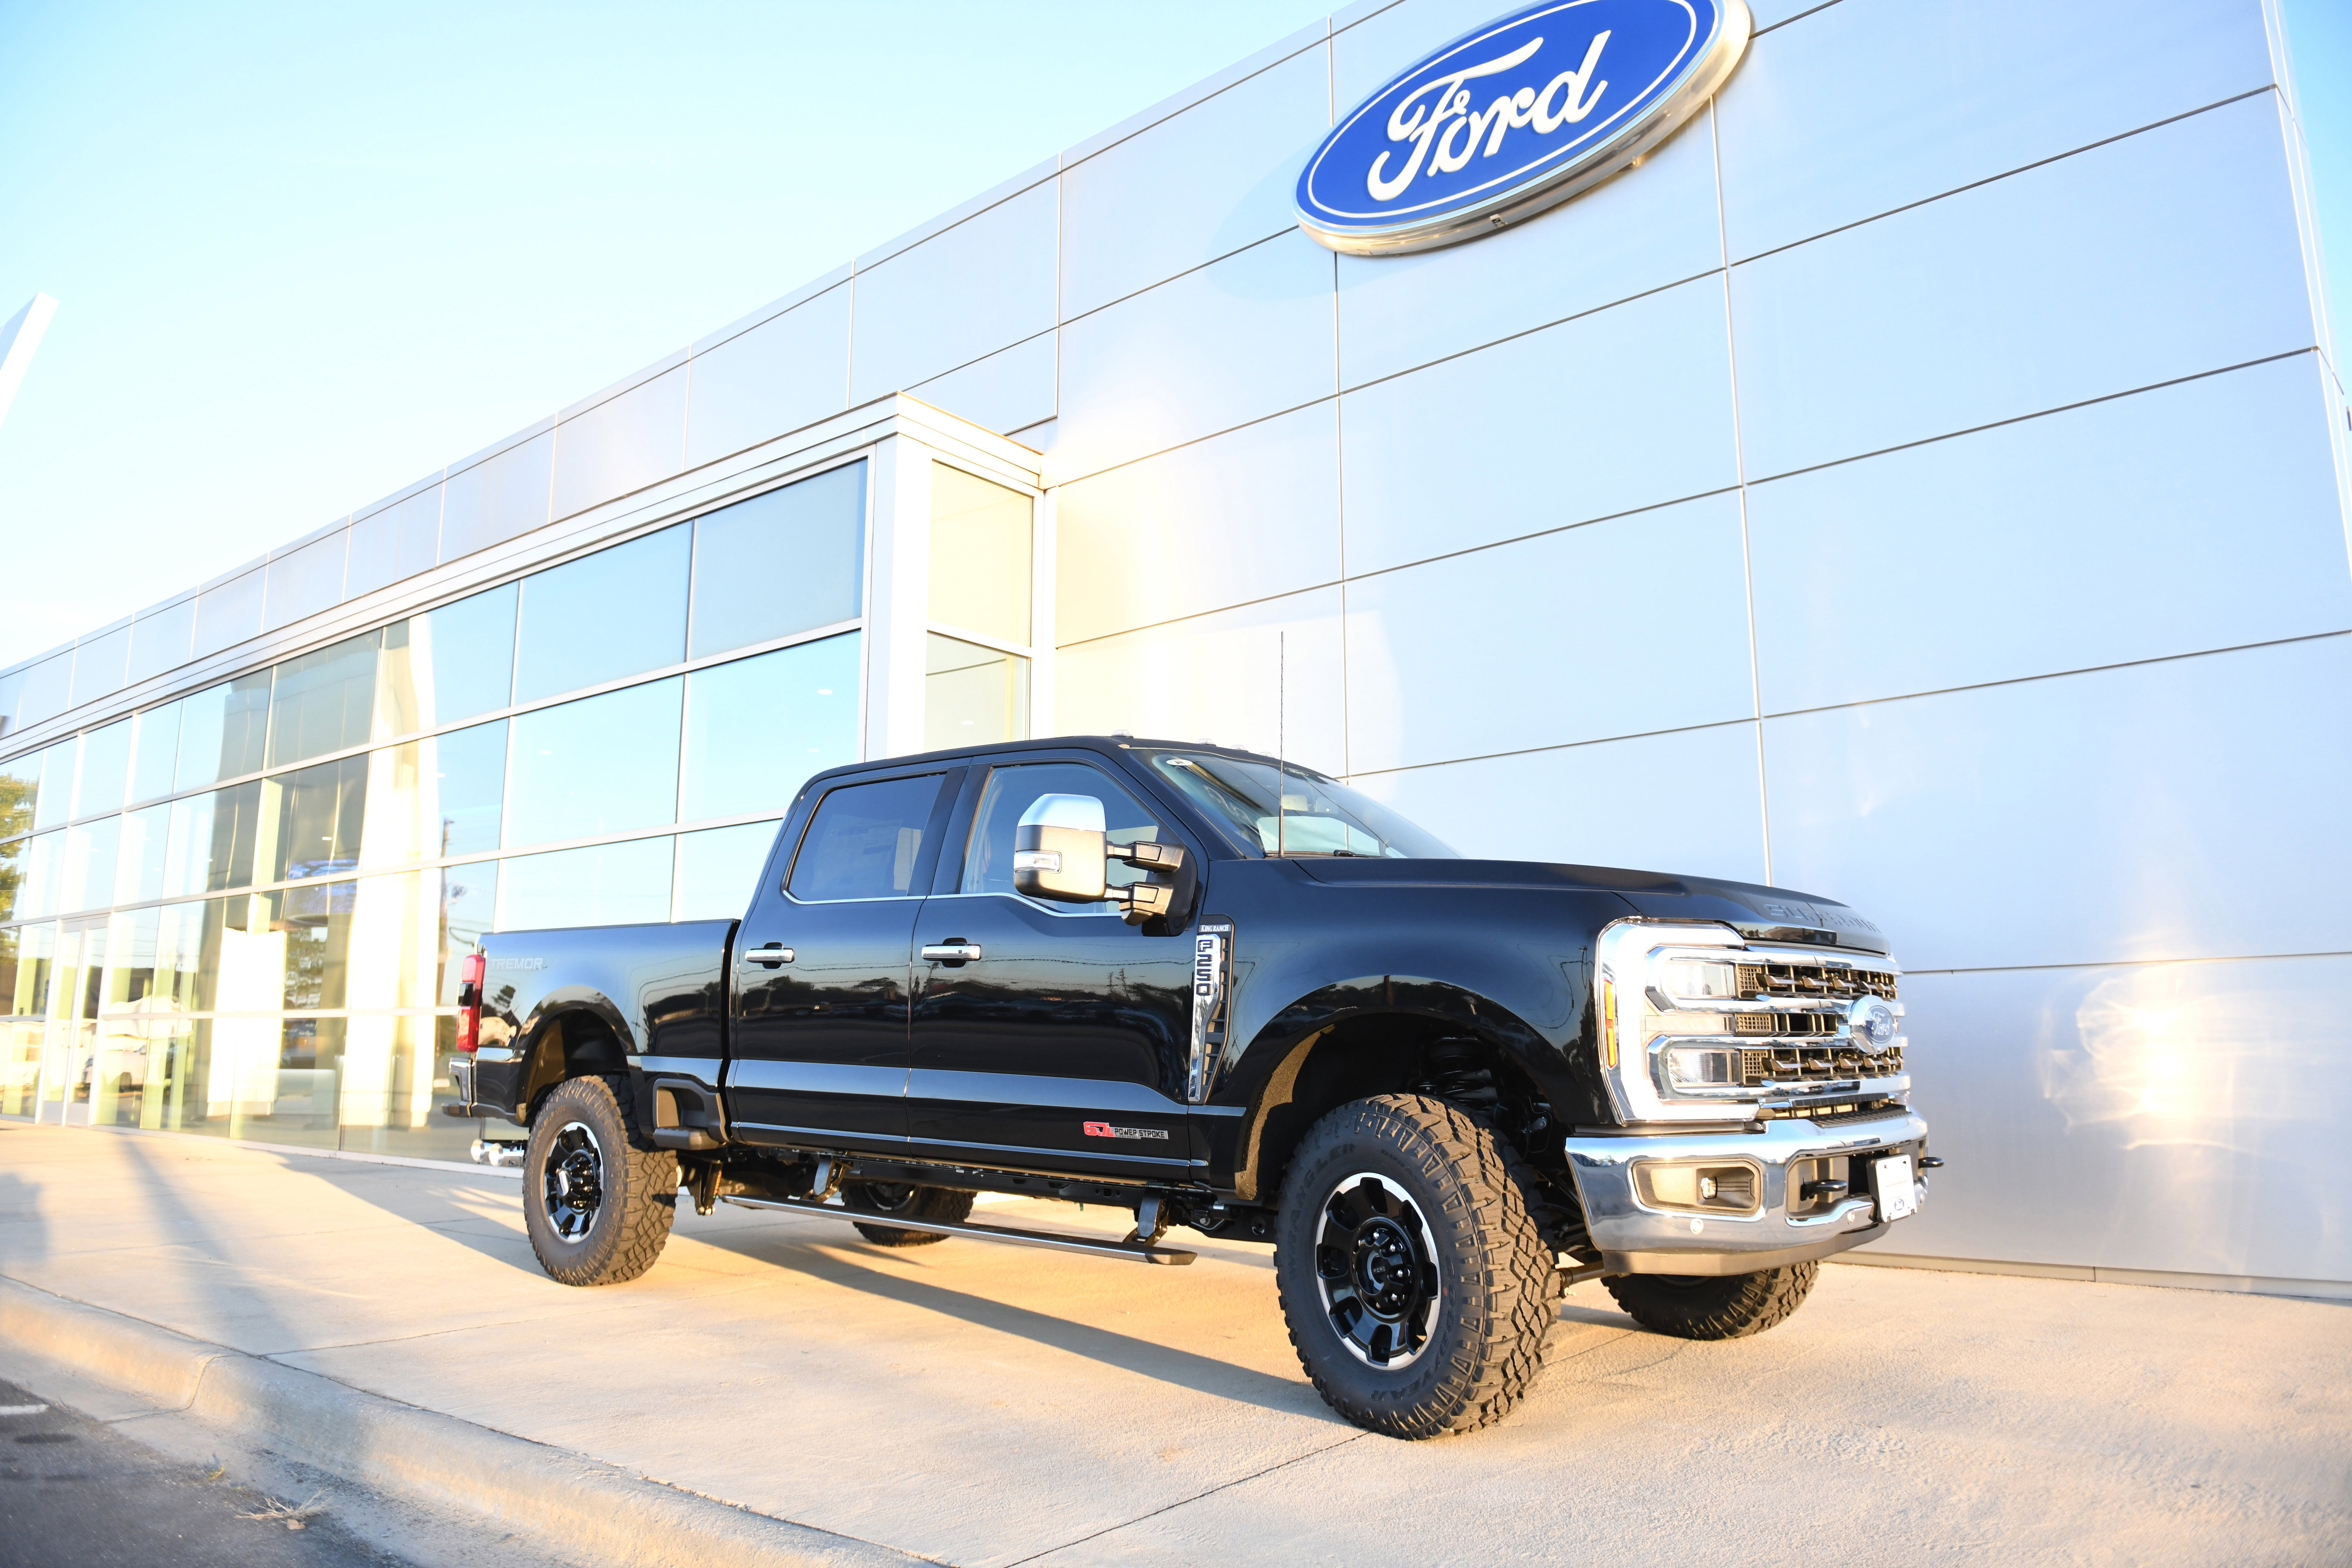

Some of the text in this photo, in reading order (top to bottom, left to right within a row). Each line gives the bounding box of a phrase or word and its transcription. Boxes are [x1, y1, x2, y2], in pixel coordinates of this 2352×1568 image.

[1367, 29, 1611, 201] Ford
[490, 958, 543, 970] TREMOR
[1196, 940, 1213, 996] F250
[1871, 1011, 1891, 1036] Ford
[1083, 1121, 1165, 1138] 6.7L POWER STROKE
